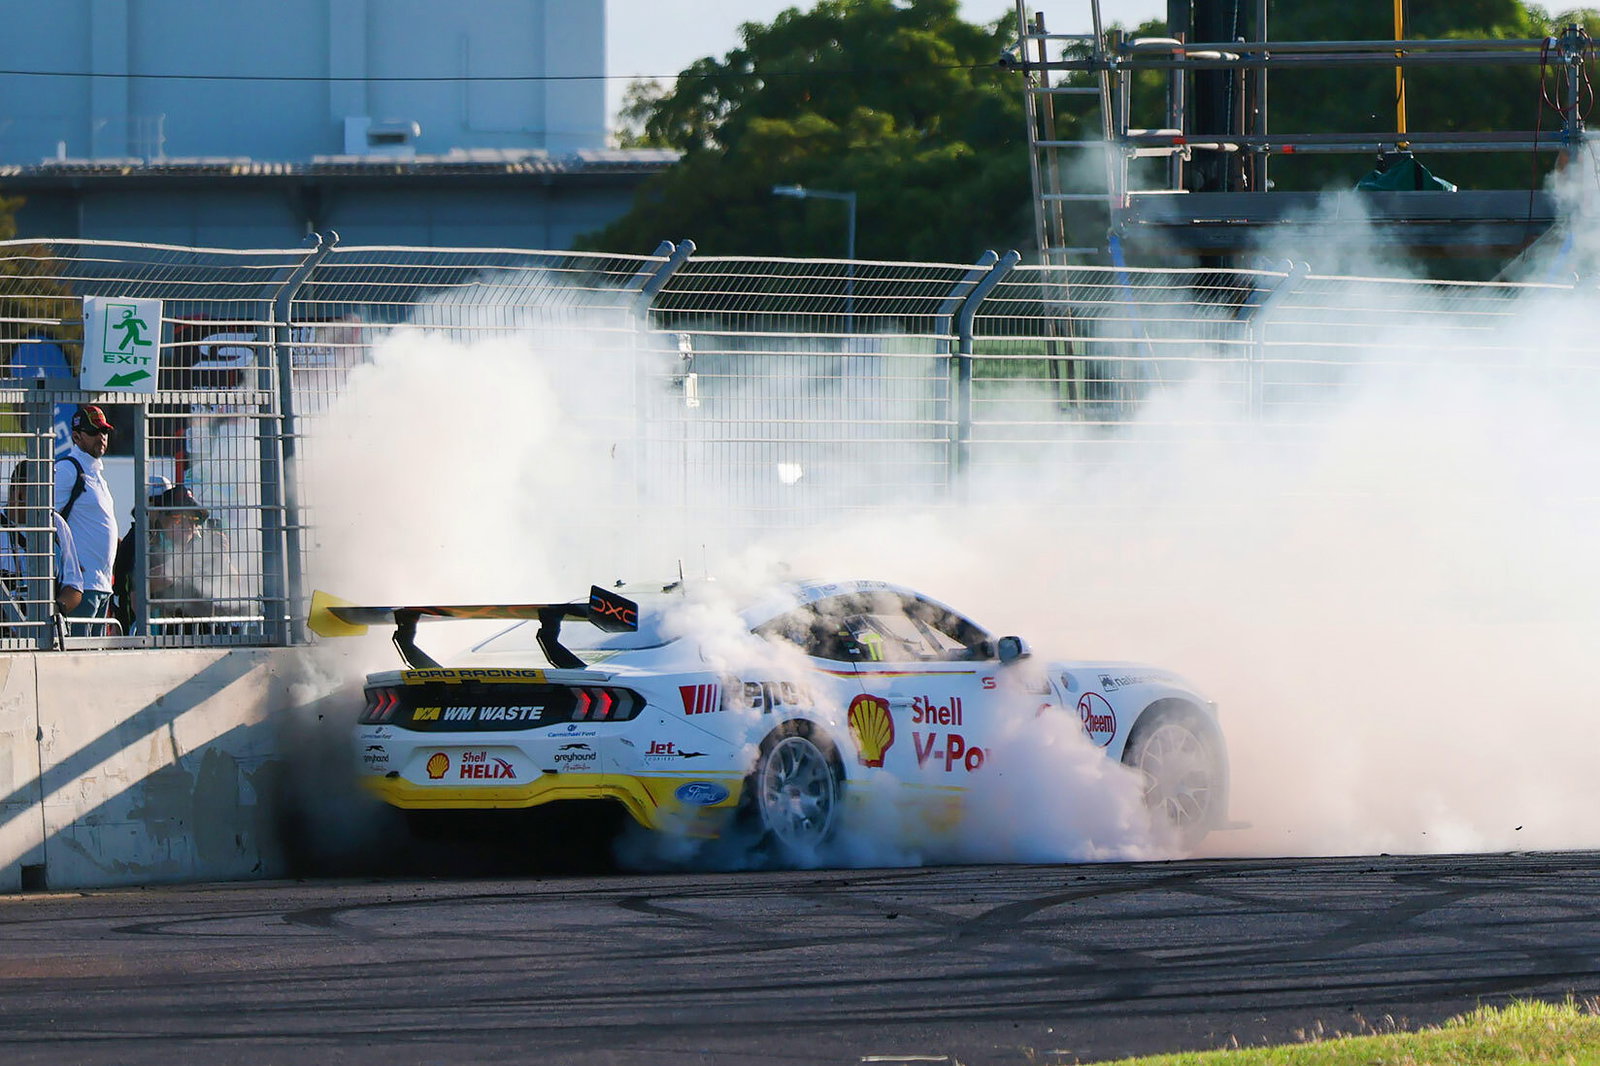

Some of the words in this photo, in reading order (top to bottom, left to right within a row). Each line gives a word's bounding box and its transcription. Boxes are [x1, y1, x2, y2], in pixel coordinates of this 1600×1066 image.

[103, 354, 152, 365] EXIT
[406, 669, 455, 679] FORD
[459, 669, 537, 678] RACING
[443, 706, 477, 720] WM
[479, 706, 545, 720] WASTE
[911, 695, 963, 726] Shell
[1080, 698, 1115, 737] Rheem
[645, 740, 676, 754] Jet
[462, 752, 487, 763] Shell
[554, 752, 597, 763] greyhound
[460, 760, 516, 779] HELIX
[687, 784, 719, 802] Ford
